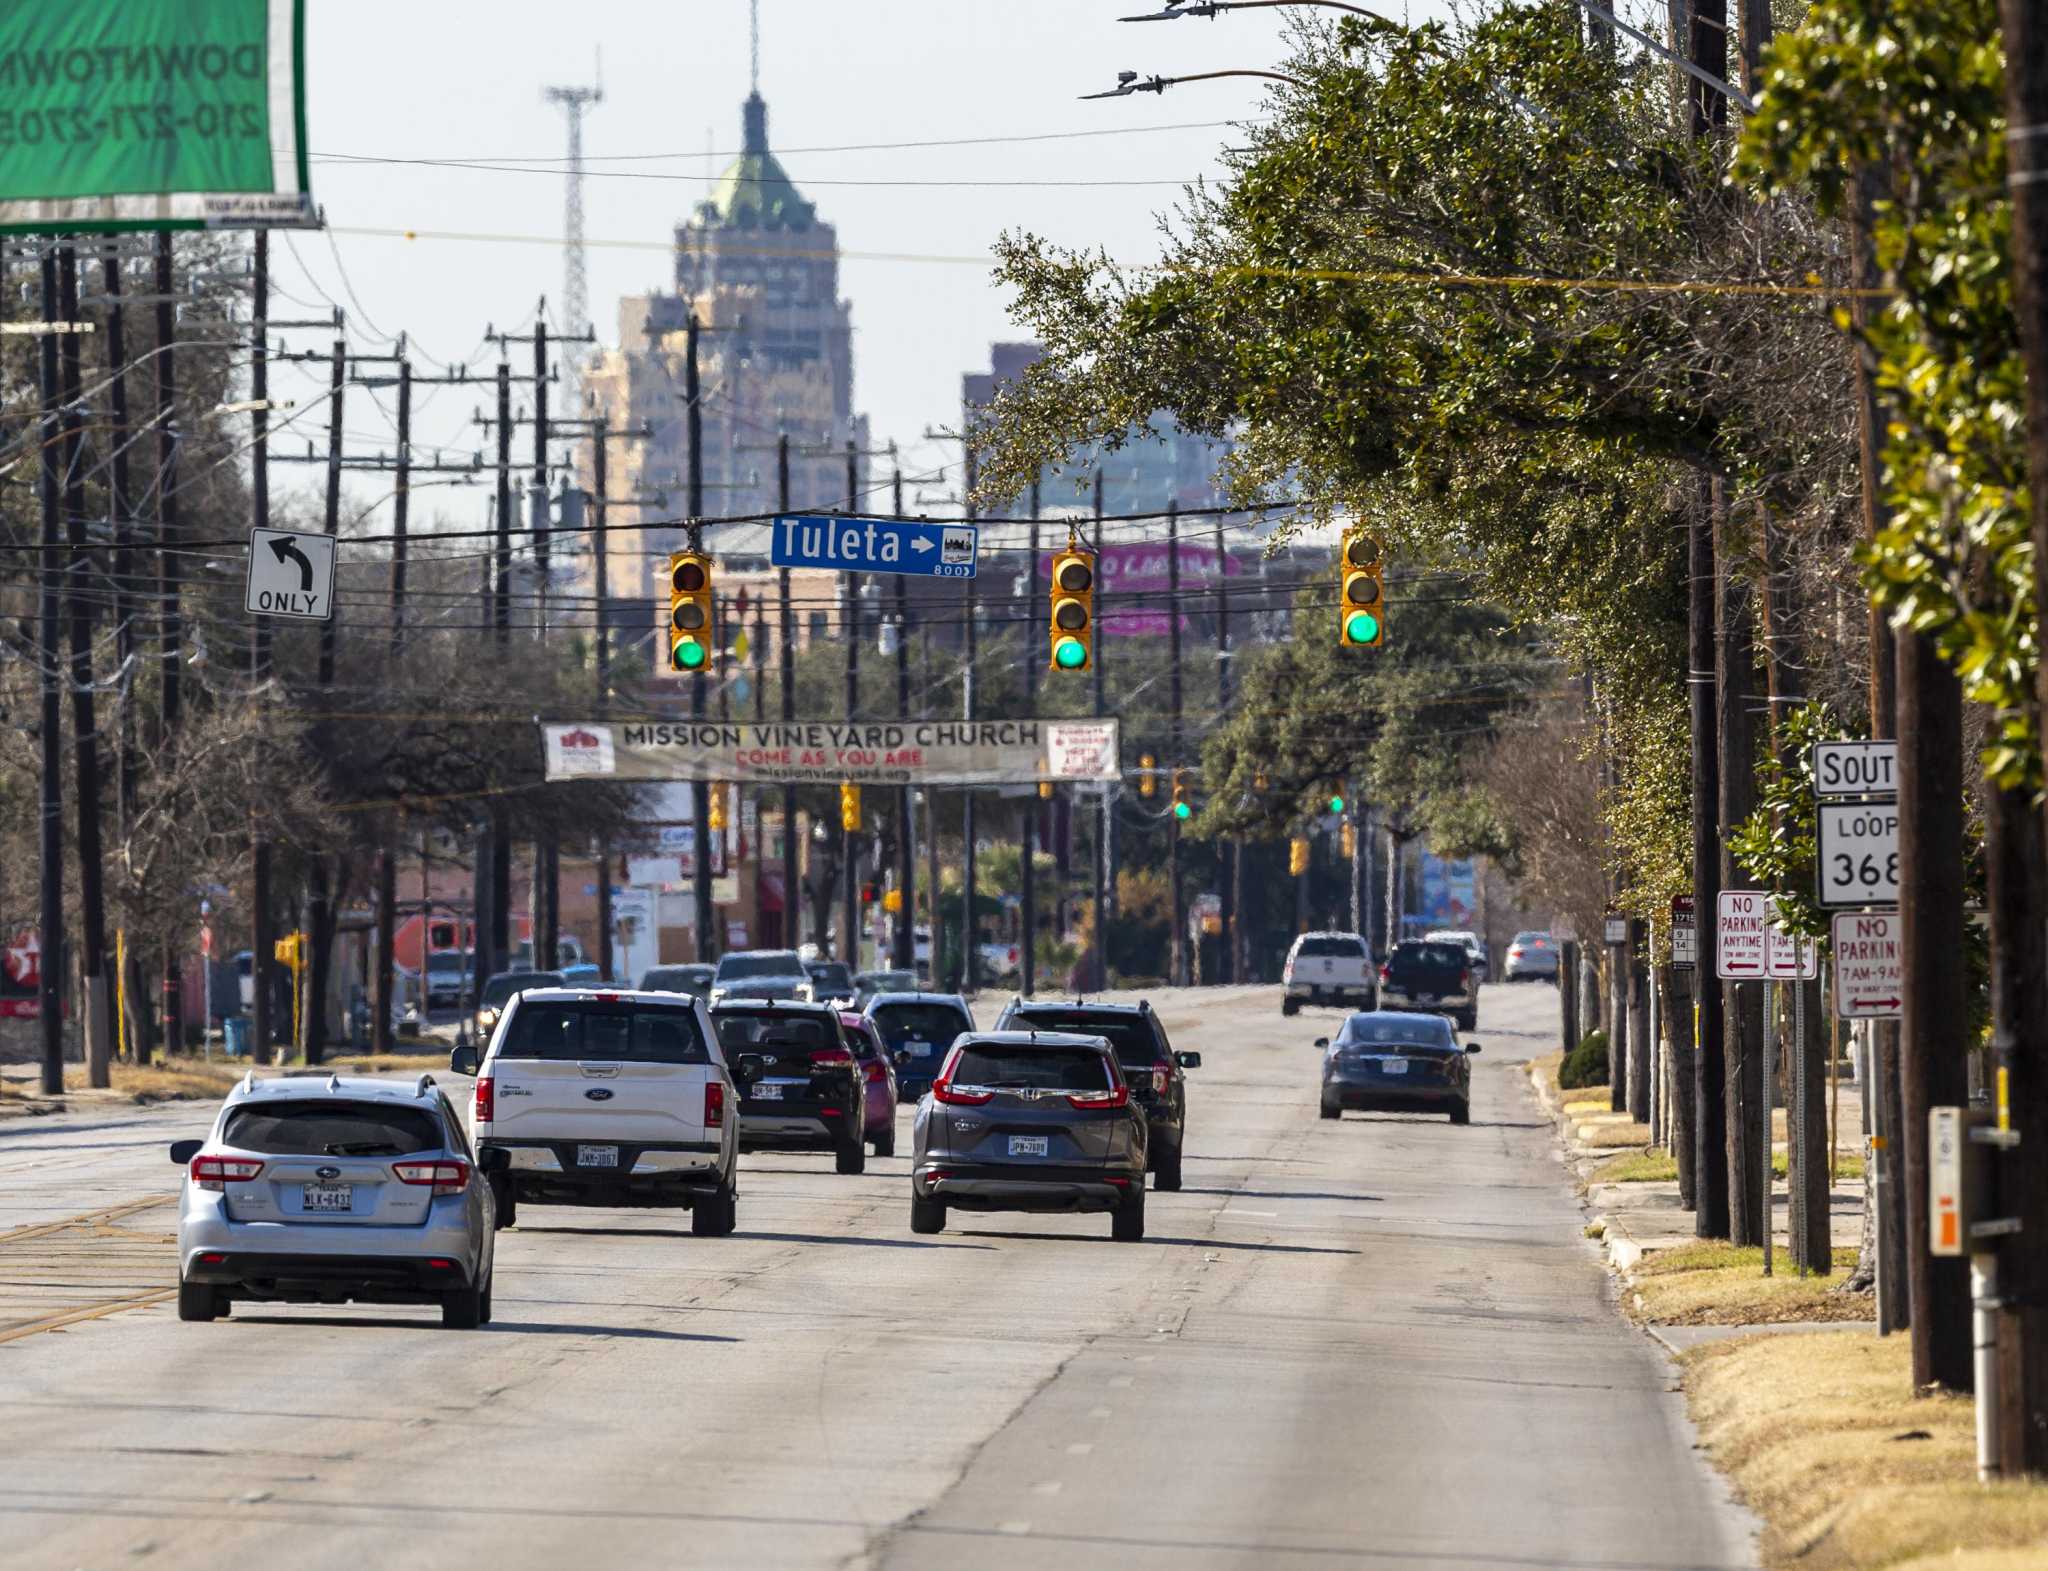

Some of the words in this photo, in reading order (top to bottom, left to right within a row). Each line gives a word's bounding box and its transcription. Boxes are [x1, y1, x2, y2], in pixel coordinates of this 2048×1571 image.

[781, 519, 900, 562] Tuleta
[934, 564, 963, 576] 800
[259, 590, 318, 614] ONLY
[623, 725, 741, 748] MISSION
[752, 724, 904, 749] VINEYARD
[915, 722, 1039, 747] CHURCH
[735, 750, 792, 767] COME
[801, 750, 827, 767] AS
[836, 749, 877, 766] YOU
[885, 748, 923, 767] ARE
[1838, 816, 1899, 838] LOOP
[1732, 897, 1753, 913] NO
[1677, 930, 1683, 938] 9
[1856, 918, 1888, 938] NO
[1675, 941, 1686, 949] 14
[1723, 936, 1762, 948] ANYTIME
[1840, 941, 1901, 961] PARKIN
